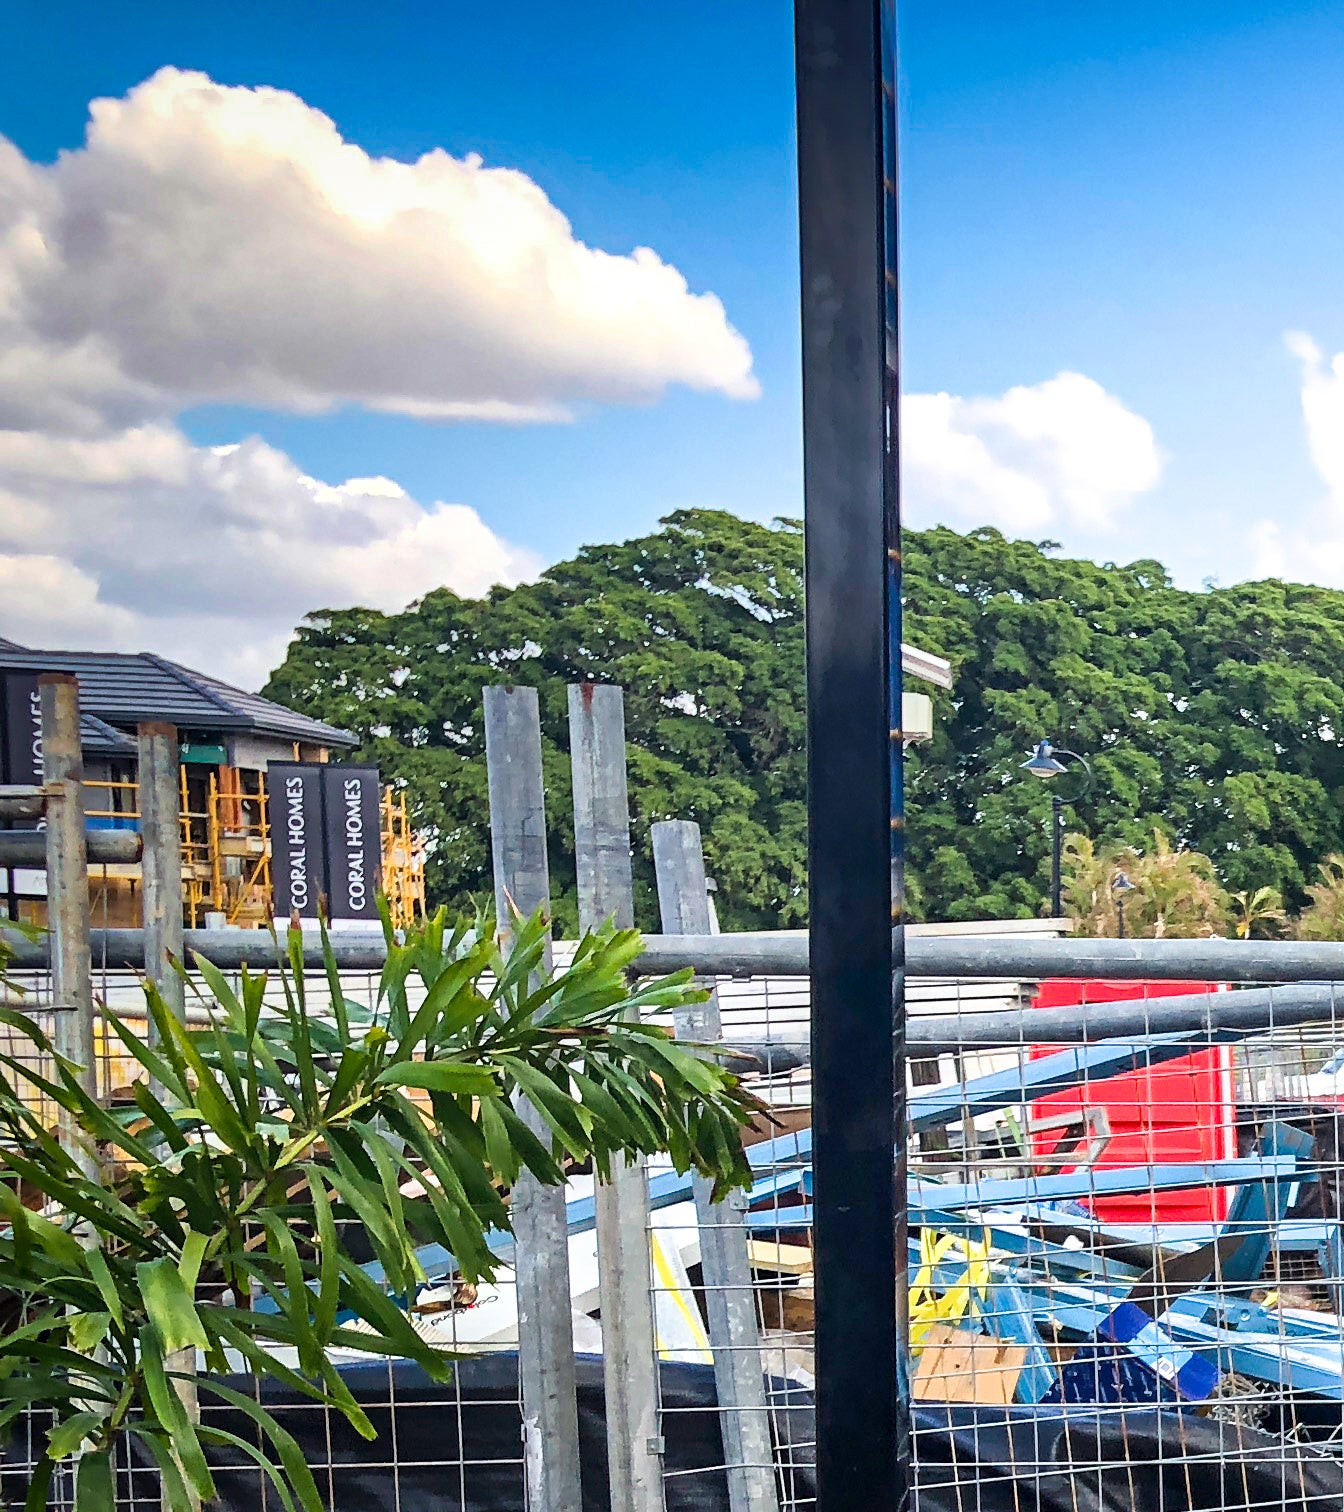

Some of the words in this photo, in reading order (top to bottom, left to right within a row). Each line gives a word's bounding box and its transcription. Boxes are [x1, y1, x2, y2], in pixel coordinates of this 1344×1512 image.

[286, 776, 305, 844] HOMES
[344, 778, 363, 846] HOMES
[289, 847, 308, 909] CORAL
[347, 849, 366, 911] CORAL
